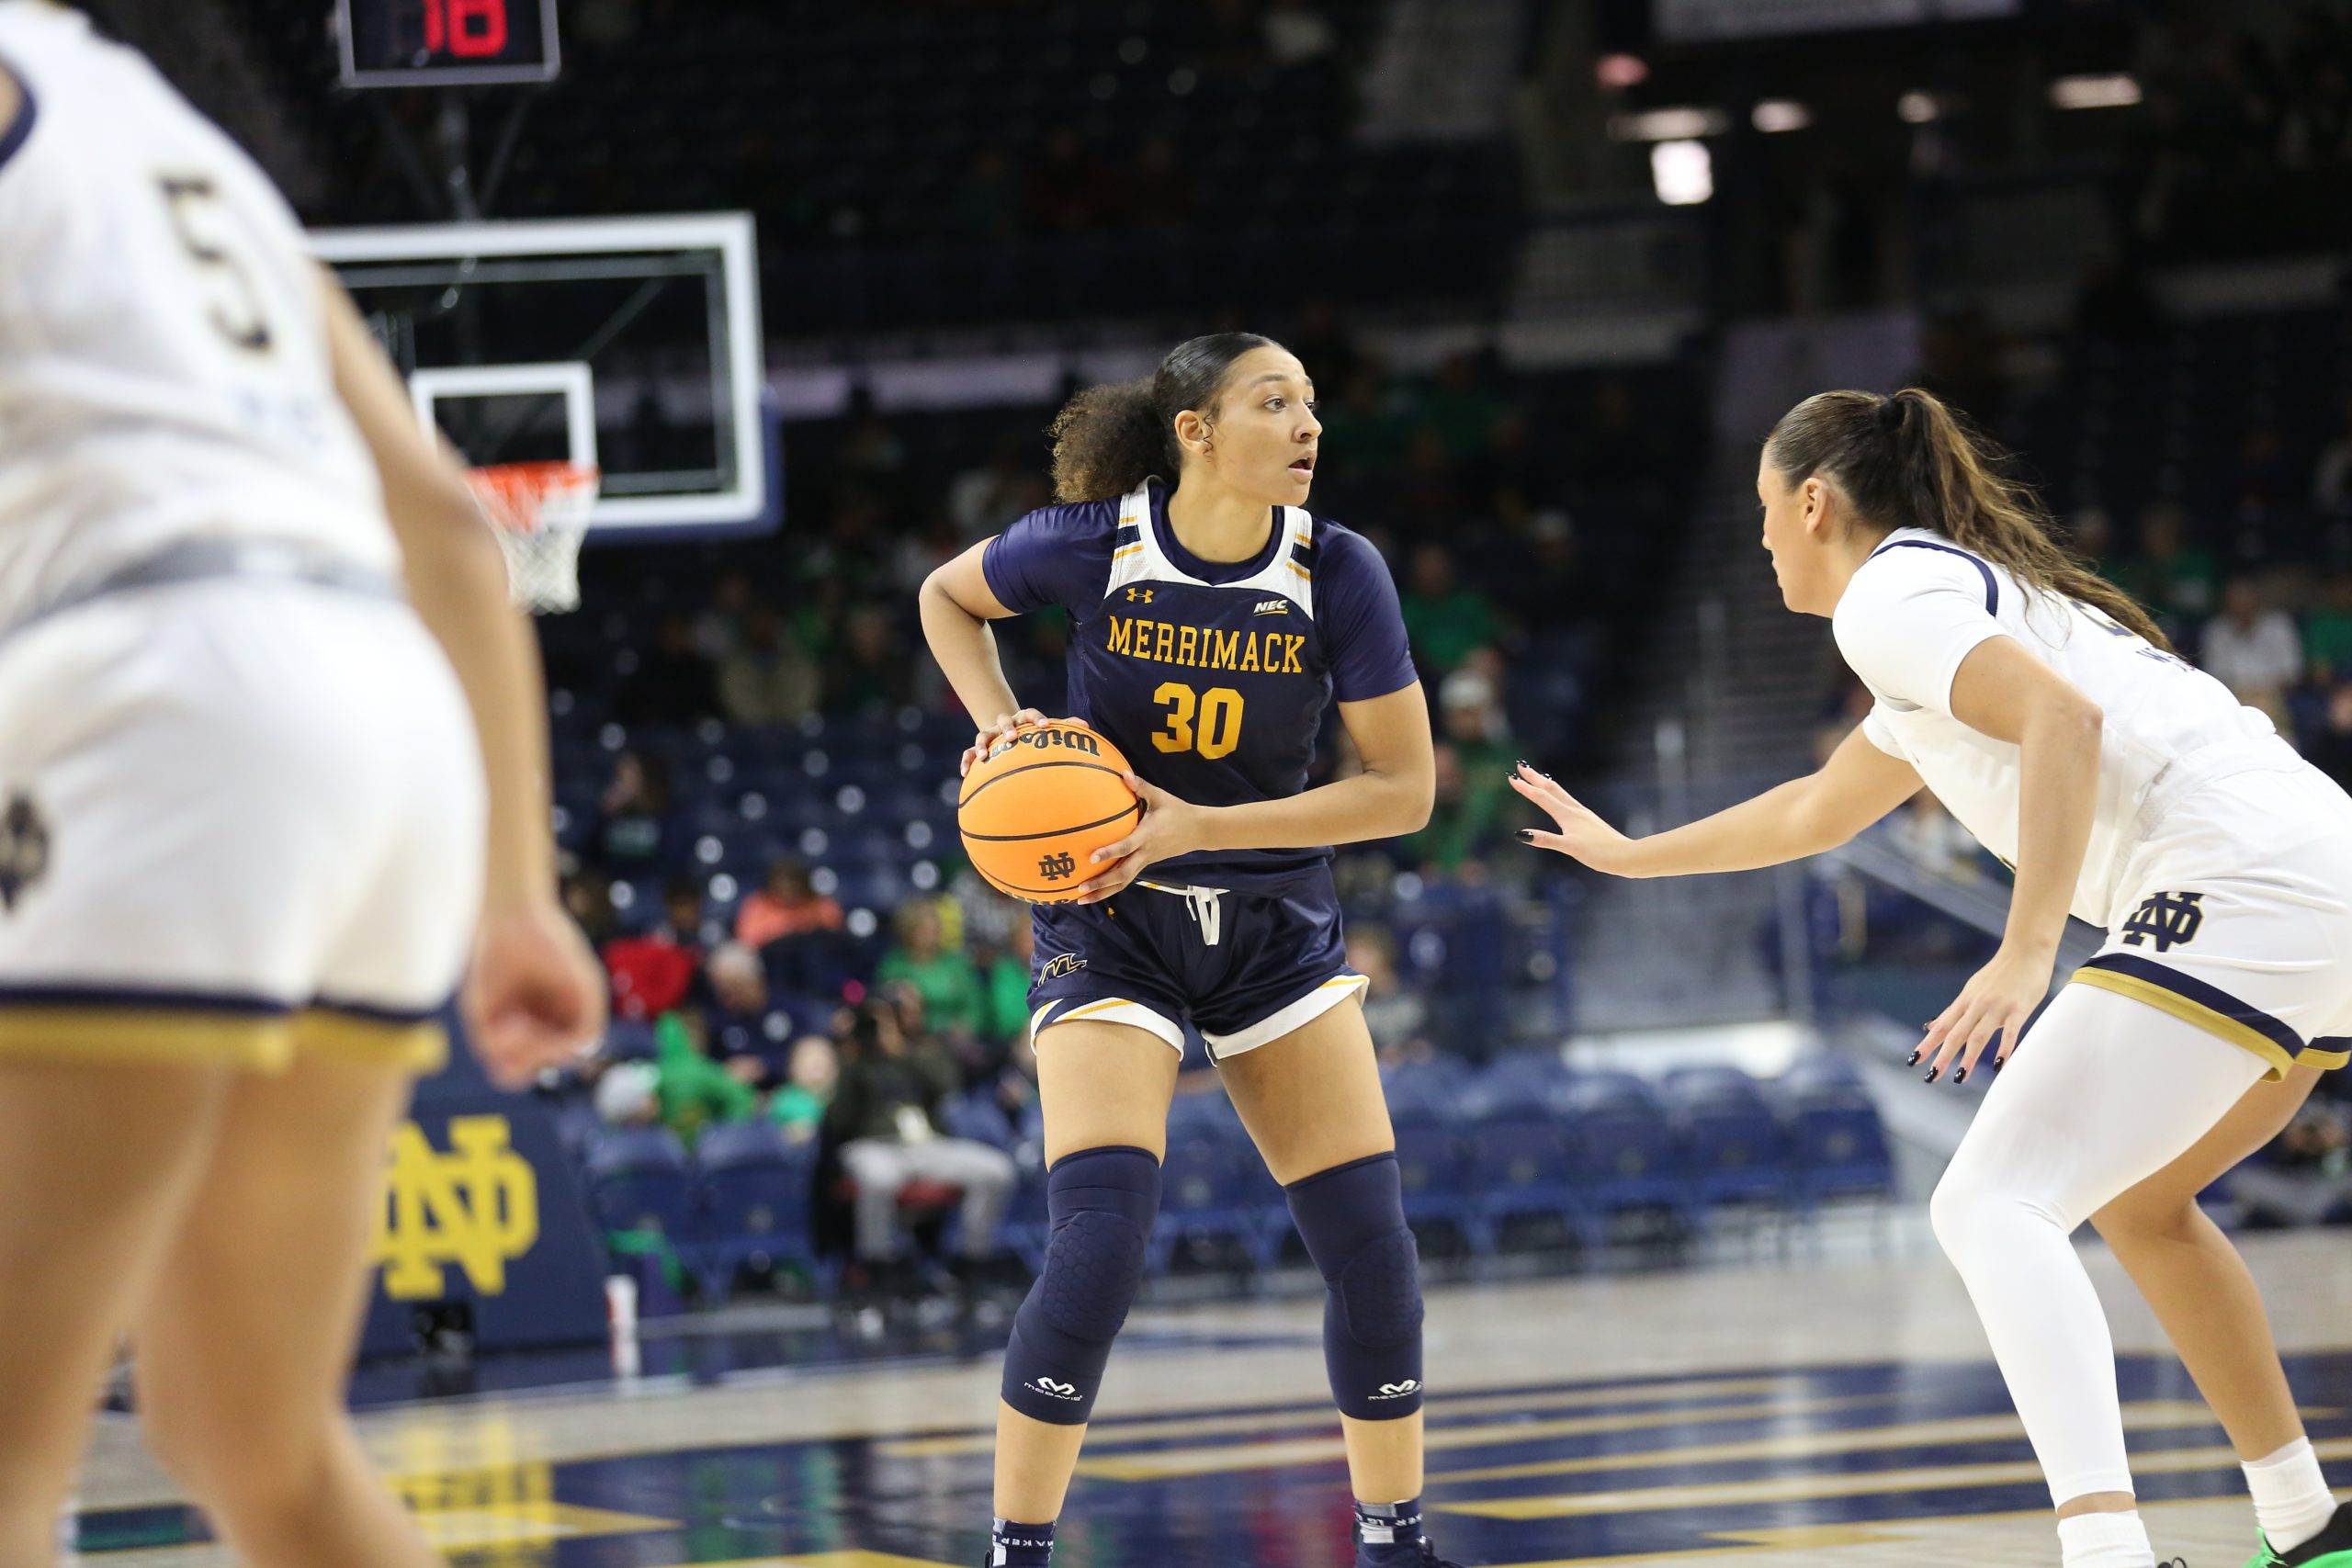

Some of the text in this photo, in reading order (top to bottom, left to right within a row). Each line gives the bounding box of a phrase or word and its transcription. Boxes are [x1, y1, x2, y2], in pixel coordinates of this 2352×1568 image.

[158, 177, 270, 349] 5
[1253, 600, 1288, 614] NEC
[1106, 615, 1306, 672] MERRIMACK
[1151, 682, 1245, 760] 30
